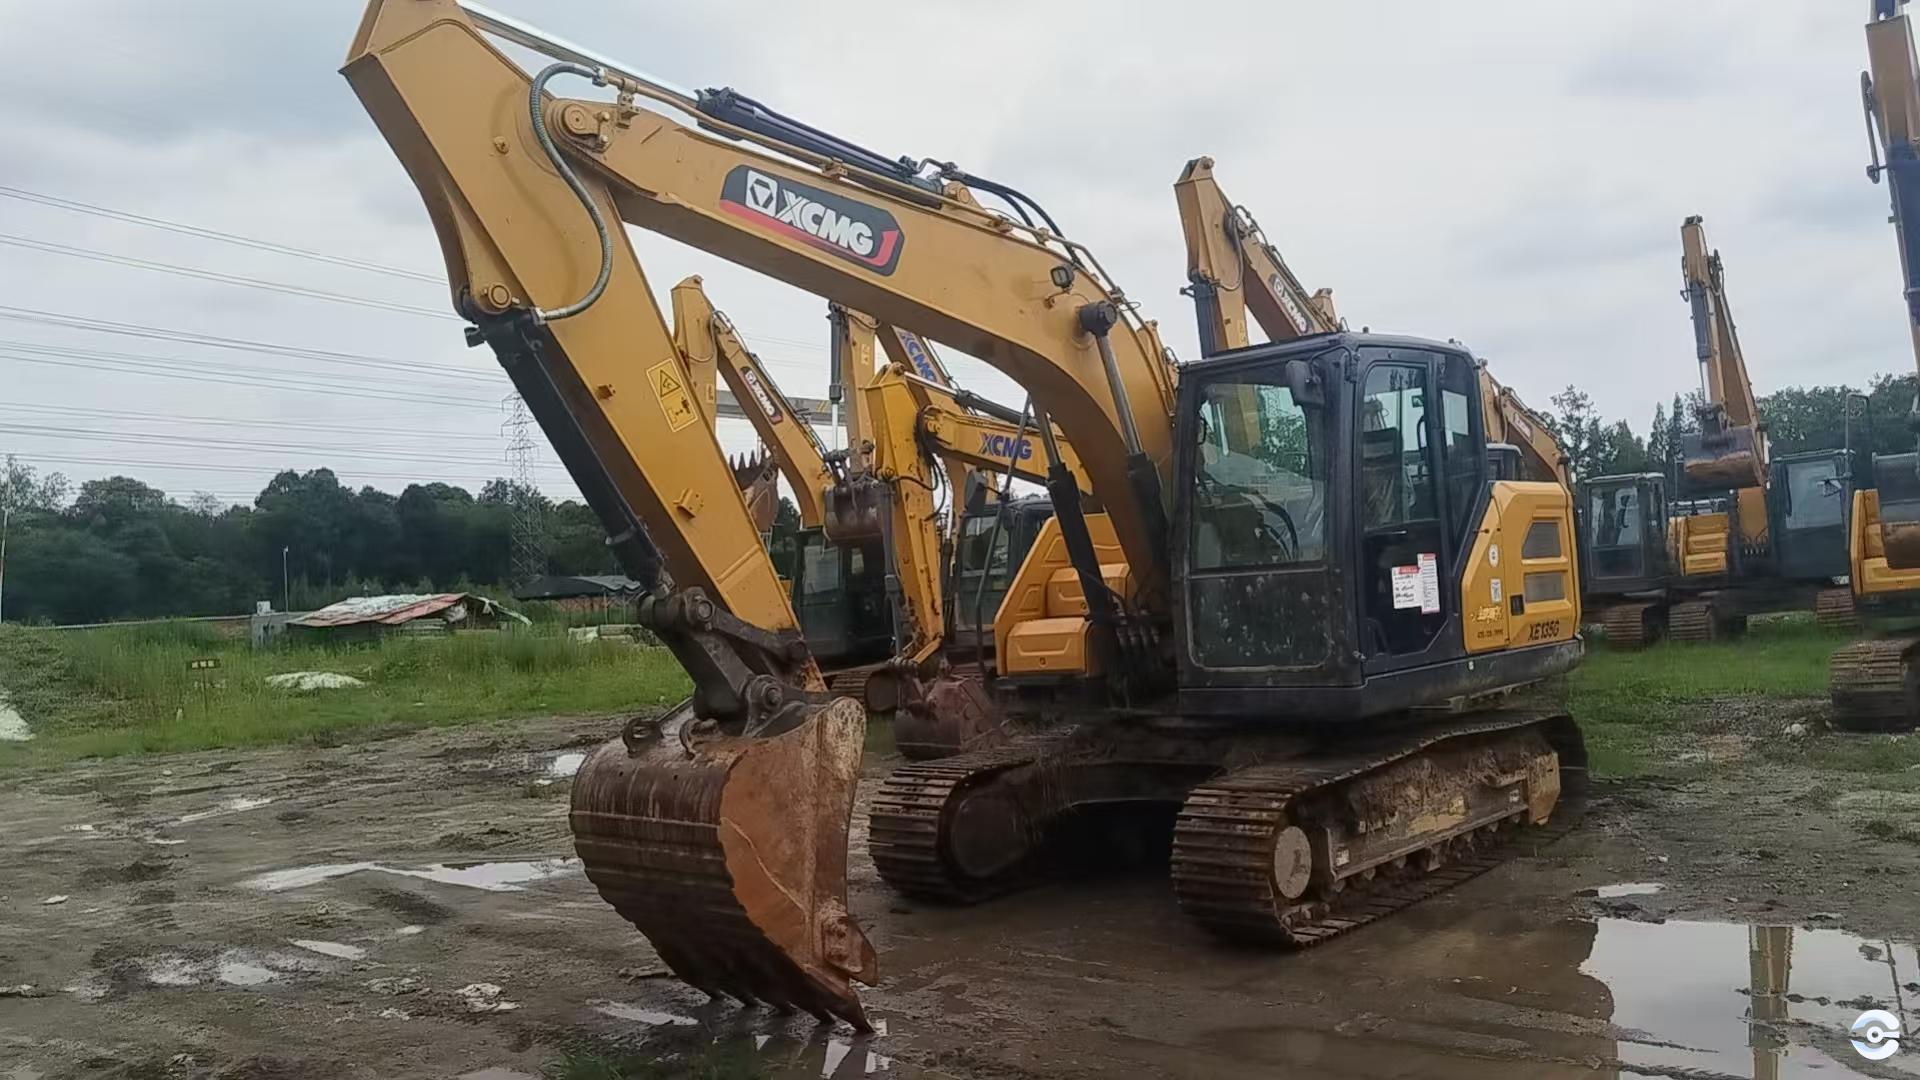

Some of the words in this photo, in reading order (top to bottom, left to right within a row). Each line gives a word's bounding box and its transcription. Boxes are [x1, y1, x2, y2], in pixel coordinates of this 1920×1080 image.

[776, 188, 874, 256] XCMG
[751, 381, 775, 416] XCMG
[1528, 619, 1560, 642] XE135G
